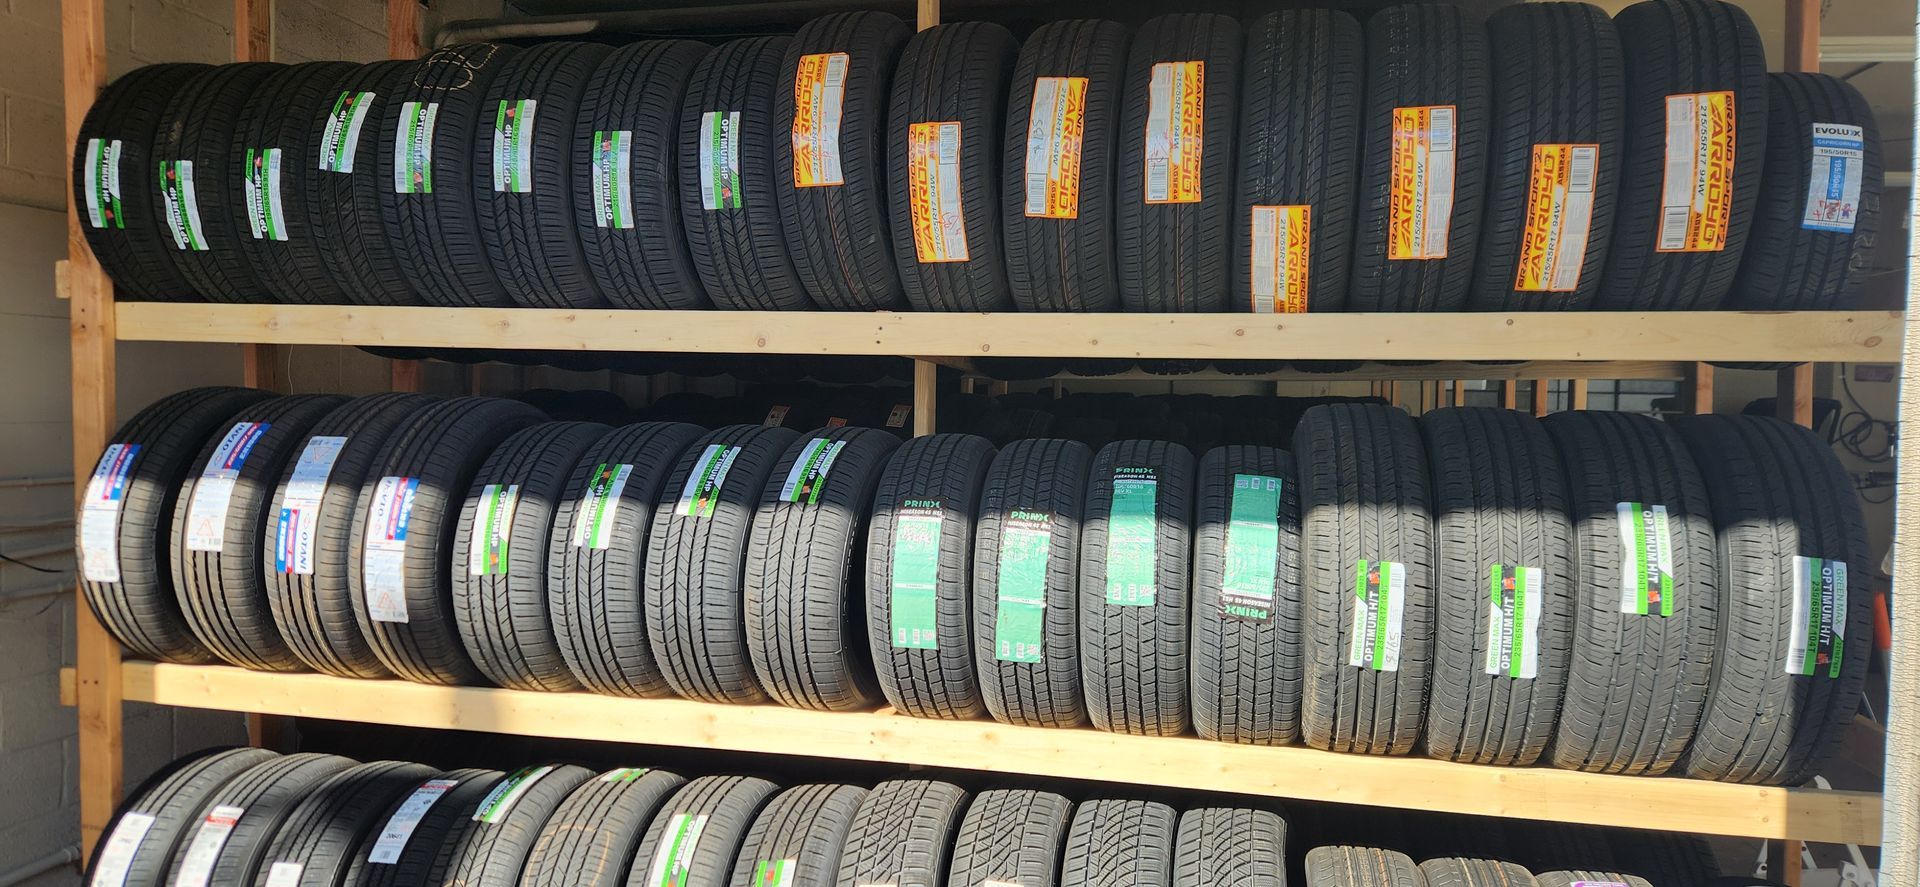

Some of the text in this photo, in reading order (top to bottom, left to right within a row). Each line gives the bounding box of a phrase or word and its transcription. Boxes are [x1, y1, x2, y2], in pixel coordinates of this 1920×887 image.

[800, 60, 815, 176] ARROYO
[1055, 87, 1067, 138] 215/55R17
[1076, 80, 1087, 137] GRAND
[1173, 71, 1183, 150] 215/55R17 94W
[1195, 63, 1203, 119] GRAND
[328, 110, 347, 163] OPTIMUM HP
[413, 109, 428, 165] OPTIMUM HP
[502, 124, 513, 184] OPTIMUM HP
[720, 118, 729, 180] OPTIMUM HP
[811, 94, 819, 174] 215/55R17 94W
[1052, 140, 1061, 166] 94W
[1059, 86, 1078, 211] ARROYO
[1182, 71, 1195, 196] ARROYO
[1698, 105, 1708, 196] 215/55R17 94W
[1725, 94, 1733, 162] GRAND
[101, 147, 111, 203] OPTIMUM HP
[169, 187, 178, 200] HP
[602, 159, 613, 220] OPTIMUM HP
[917, 128, 934, 248] ARROYO
[1400, 115, 1415, 250] ARROYO
[1703, 102, 1724, 245] ARROYO
[171, 200, 190, 243] OPTIMUM
[254, 174, 268, 232] OPTIMUM HP
[911, 203, 925, 260] GRAND
[929, 173, 942, 253] 215/55R17 94W
[1390, 194, 1398, 256] GRAND
[1413, 161, 1424, 248] 215/55R17 94W
[1531, 153, 1555, 286] ARROYO
[1279, 218, 1288, 270] 215/55R17
[1301, 209, 1309, 268] GRAND
[1517, 232, 1533, 289] GRAND
[1542, 201, 1561, 281] 215/55R17 94W
[1279, 271, 1287, 291] 94W
[222, 424, 245, 451] OTANI
[808, 442, 835, 481] OPTIMUM HP
[704, 449, 731, 493] OPTIMUM HP
[493, 491, 508, 534] OPTIMUM
[584, 484, 605, 540] OPTIMUM HP
[904, 500, 941, 508] PRINX
[1010, 511, 1050, 522] PRINX
[300, 531, 308, 571] OTANI
[491, 534, 500, 547] HP
[1642, 510, 1659, 584] OPTIMUM H/T
[1660, 543, 1669, 566] MAX
[1225, 604, 1268, 620] PRINX
[1376, 583, 1389, 651] 235/65R17 104T
[1513, 588, 1525, 659] 235/65R17 104T
[1806, 580, 1822, 654] 235/65R17 104T
[1819, 567, 1833, 646] OPTIMUM H/T
[1835, 568, 1845, 626] GREEN MAX
[1352, 628, 1363, 661] GREEN
[1364, 591, 1379, 662] OPTIMUM H/T
[1489, 616, 1500, 670] GREEN MAX
[1501, 596, 1515, 670] OPTIMUM H/T
